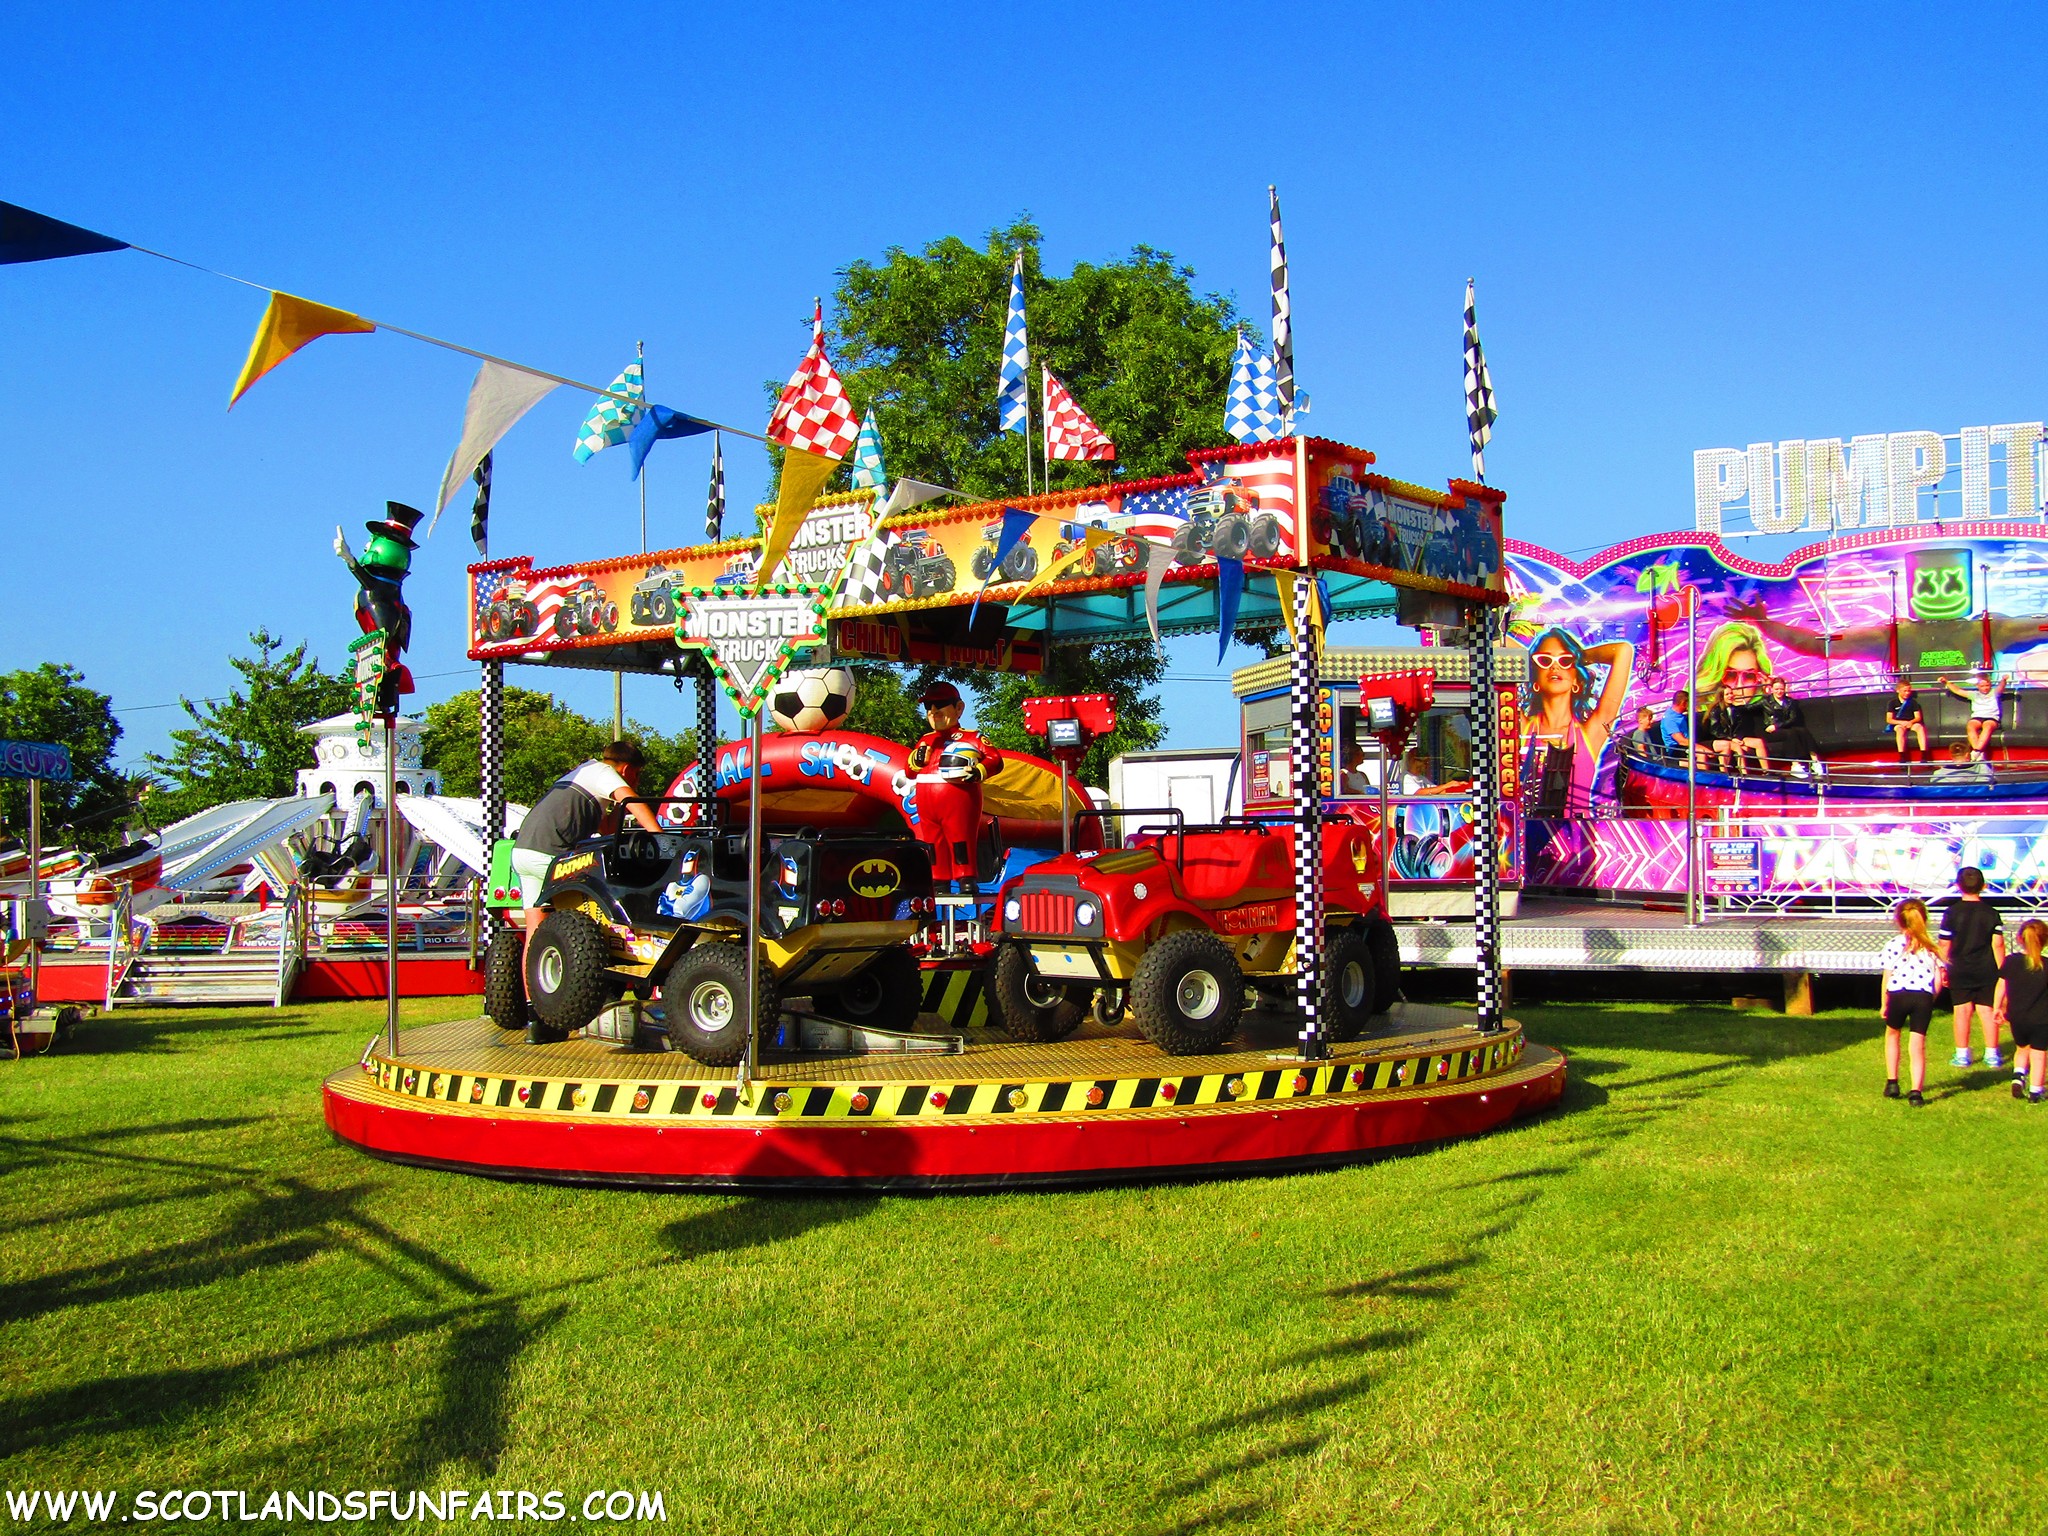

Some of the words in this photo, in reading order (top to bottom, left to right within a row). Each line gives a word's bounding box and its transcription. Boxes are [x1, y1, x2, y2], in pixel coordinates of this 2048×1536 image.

[1693, 431, 1946, 537] PUMP
[1960, 421, 2044, 521] IT
[790, 514, 873, 549] ONSTER
[1388, 504, 1433, 532] MONSTER
[1399, 526, 1425, 548] TRUCKS
[790, 547, 847, 575] TRUCKS
[684, 610, 820, 639] MONSTER
[841, 620, 901, 656] CHILD
[716, 638, 779, 663] TRUCK
[1318, 688, 1332, 733] PAY
[1500, 691, 1515, 736] PAY
[1319, 737, 1333, 797] HERE
[1500, 739, 1516, 797] HERE
[554, 851, 594, 880] BATMAN
[1216, 908, 1248, 931] IRON
[1248, 905, 1278, 928] MAN
